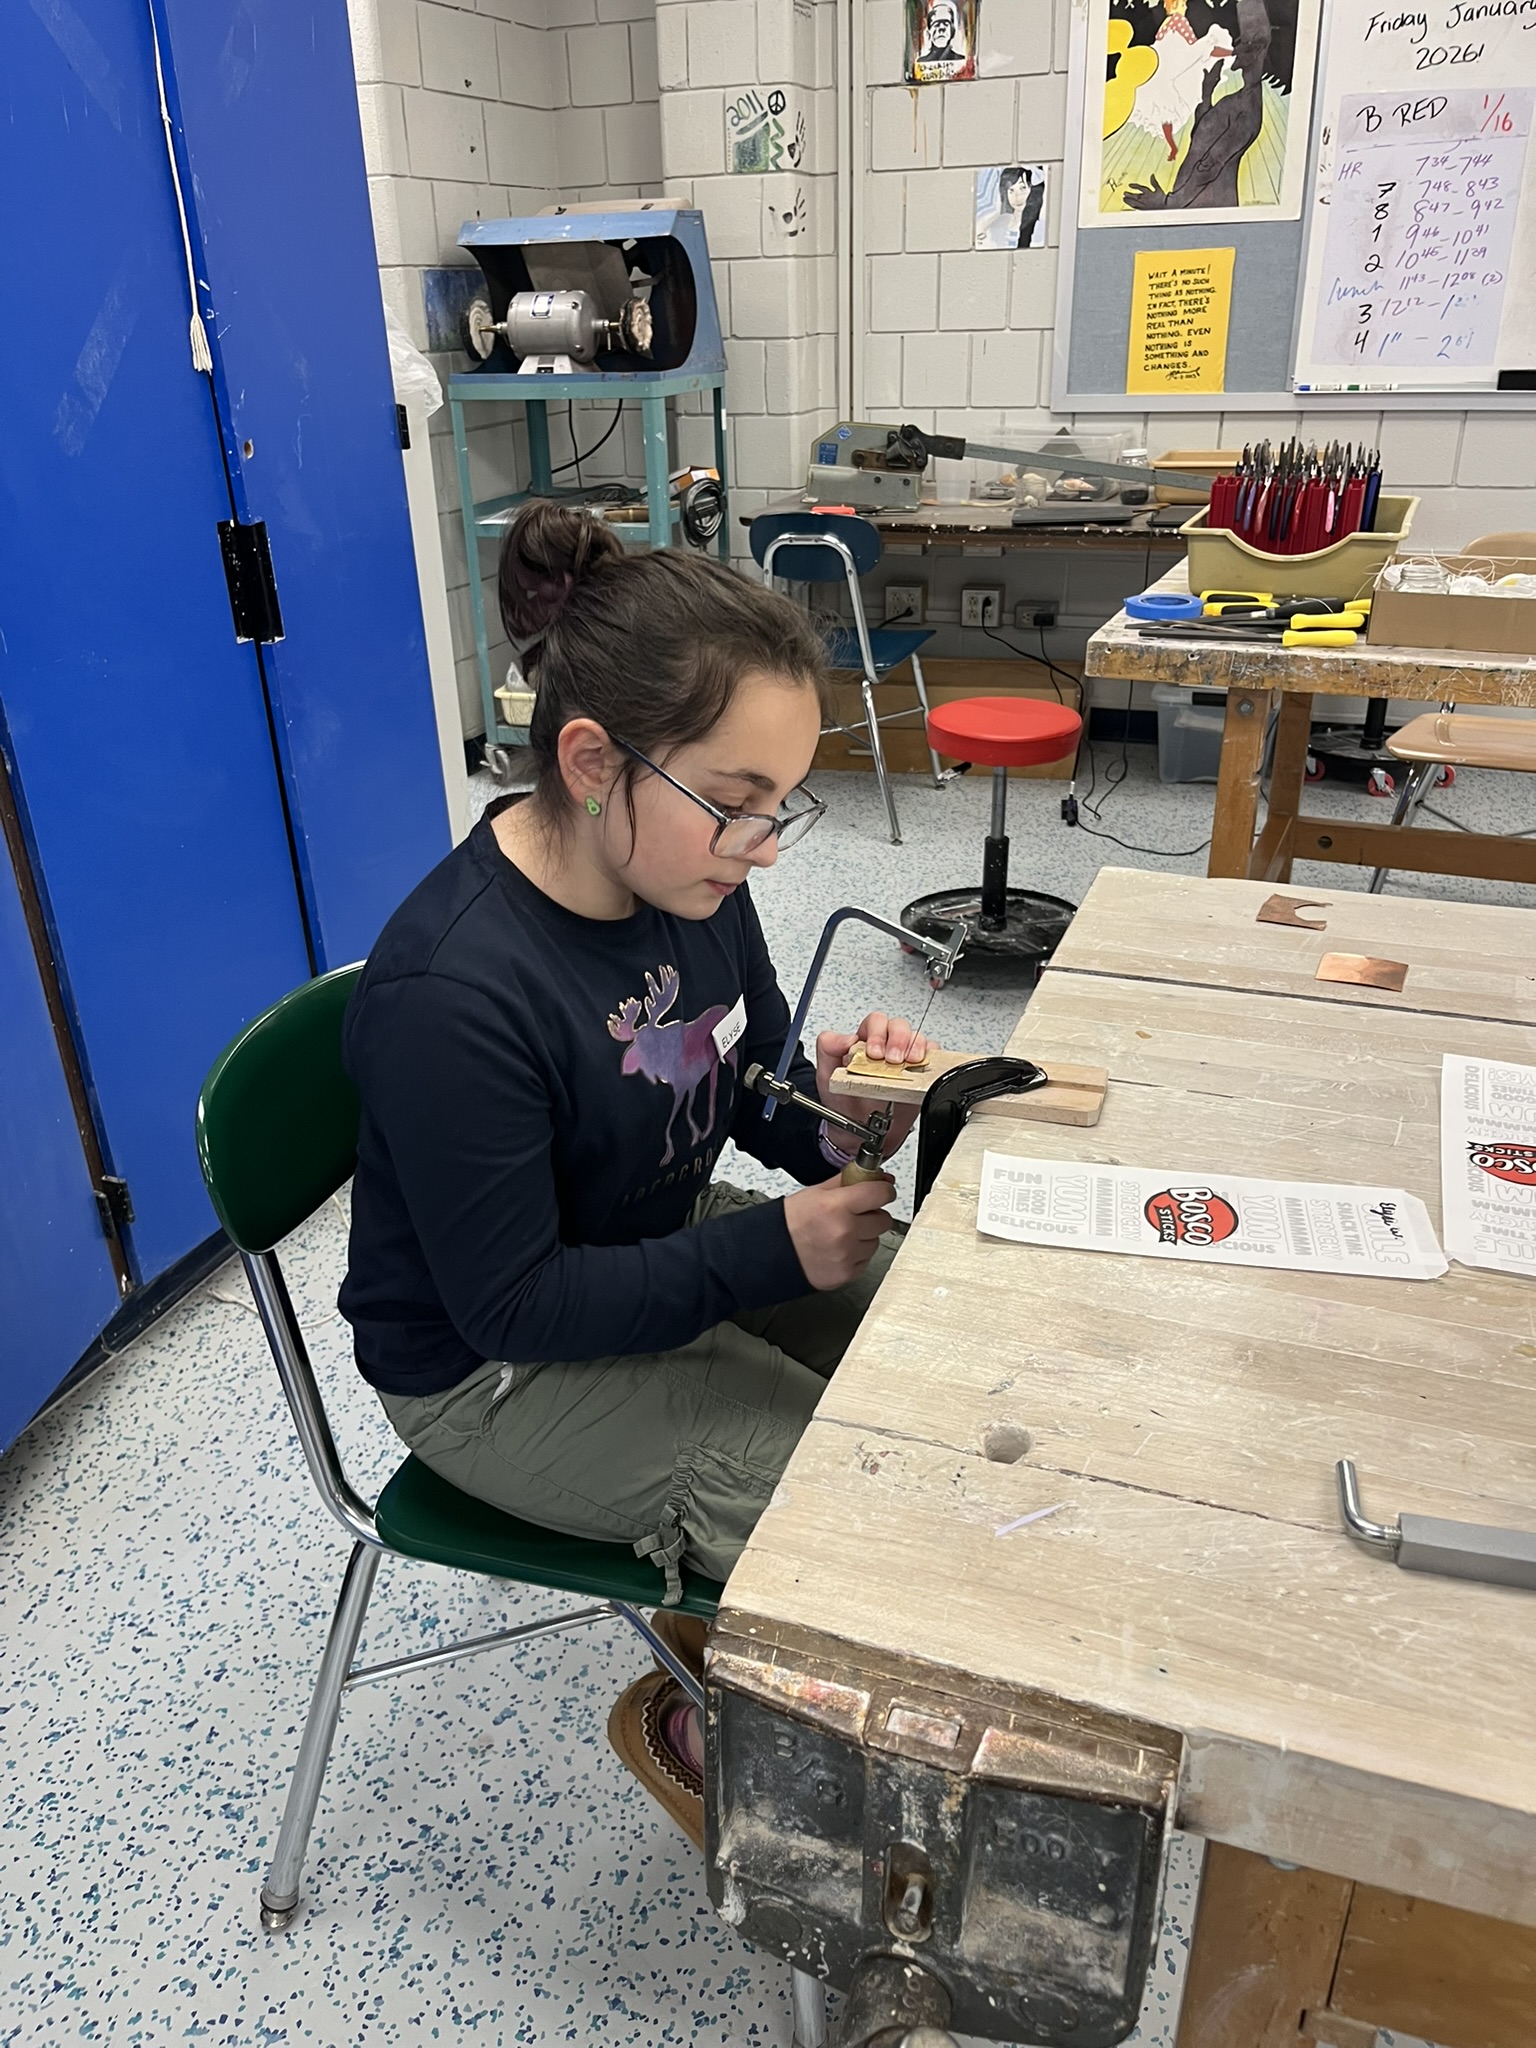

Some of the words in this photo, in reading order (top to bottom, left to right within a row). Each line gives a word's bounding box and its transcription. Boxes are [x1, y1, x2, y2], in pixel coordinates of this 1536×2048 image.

[1364, 11, 1428, 44] Friday
[1415, 43, 1485, 70] 2026!
[726, 89, 764, 127] 2011
[1356, 105, 1382, 132] B
[1392, 96, 1448, 127] RED
[1480, 93, 1513, 133] 1/16
[1338, 161, 1363, 181] HR
[1377, 182, 1397, 198] 7
[1374, 203, 1389, 220] 8
[1372, 223, 1382, 242] 1
[1148, 271, 1168, 280] WAIT
[1171, 268, 1177, 277] A
[1364, 254, 1384, 272] 2
[1148, 279, 1178, 291] THERE'S
[1148, 290, 1172, 300] THING
[1146, 309, 1178, 320] NOTHING
[1183, 305, 1208, 315] MORE
[1178, 296, 1210, 307] THERE'S
[1146, 321, 1165, 330] REAL
[1168, 318, 1194, 327] THAN
[1358, 303, 1373, 324] 3
[1187, 327, 1211, 336] EVEN
[1354, 330, 1369, 353] 4
[1144, 341, 1178, 352] NOTHING
[1183, 339, 1192, 348] IS
[1144, 350, 1189, 361] SOMETHING
[1191, 349, 1209, 358] AND
[721, 1021, 741, 1050] ELYSE
[1464, 1065, 1480, 1111] DELICIOUS
[1473, 1144, 1534, 1158] STICKS
[1470, 1152, 1536, 1174] SCO
[993, 1168, 1043, 1186] FUN
[988, 1184, 1012, 1212] YES!
[1015, 1188, 1030, 1213] TIMES
[1030, 1189, 1046, 1215] GOOD
[1053, 1175, 1088, 1221] YUM
[1120, 1180, 1141, 1242] STRETCHY
[1167, 1186, 1213, 1246] BOSCO
[1243, 1194, 1282, 1240] YUM
[1336, 1201, 1359, 1233] SNACK
[988, 1212, 1079, 1235] DELICIOUS
[1159, 1208, 1176, 1242] STICKS
[1310, 1199, 1344, 1260] STRETCHY
[1343, 1233, 1365, 1257] TIME
